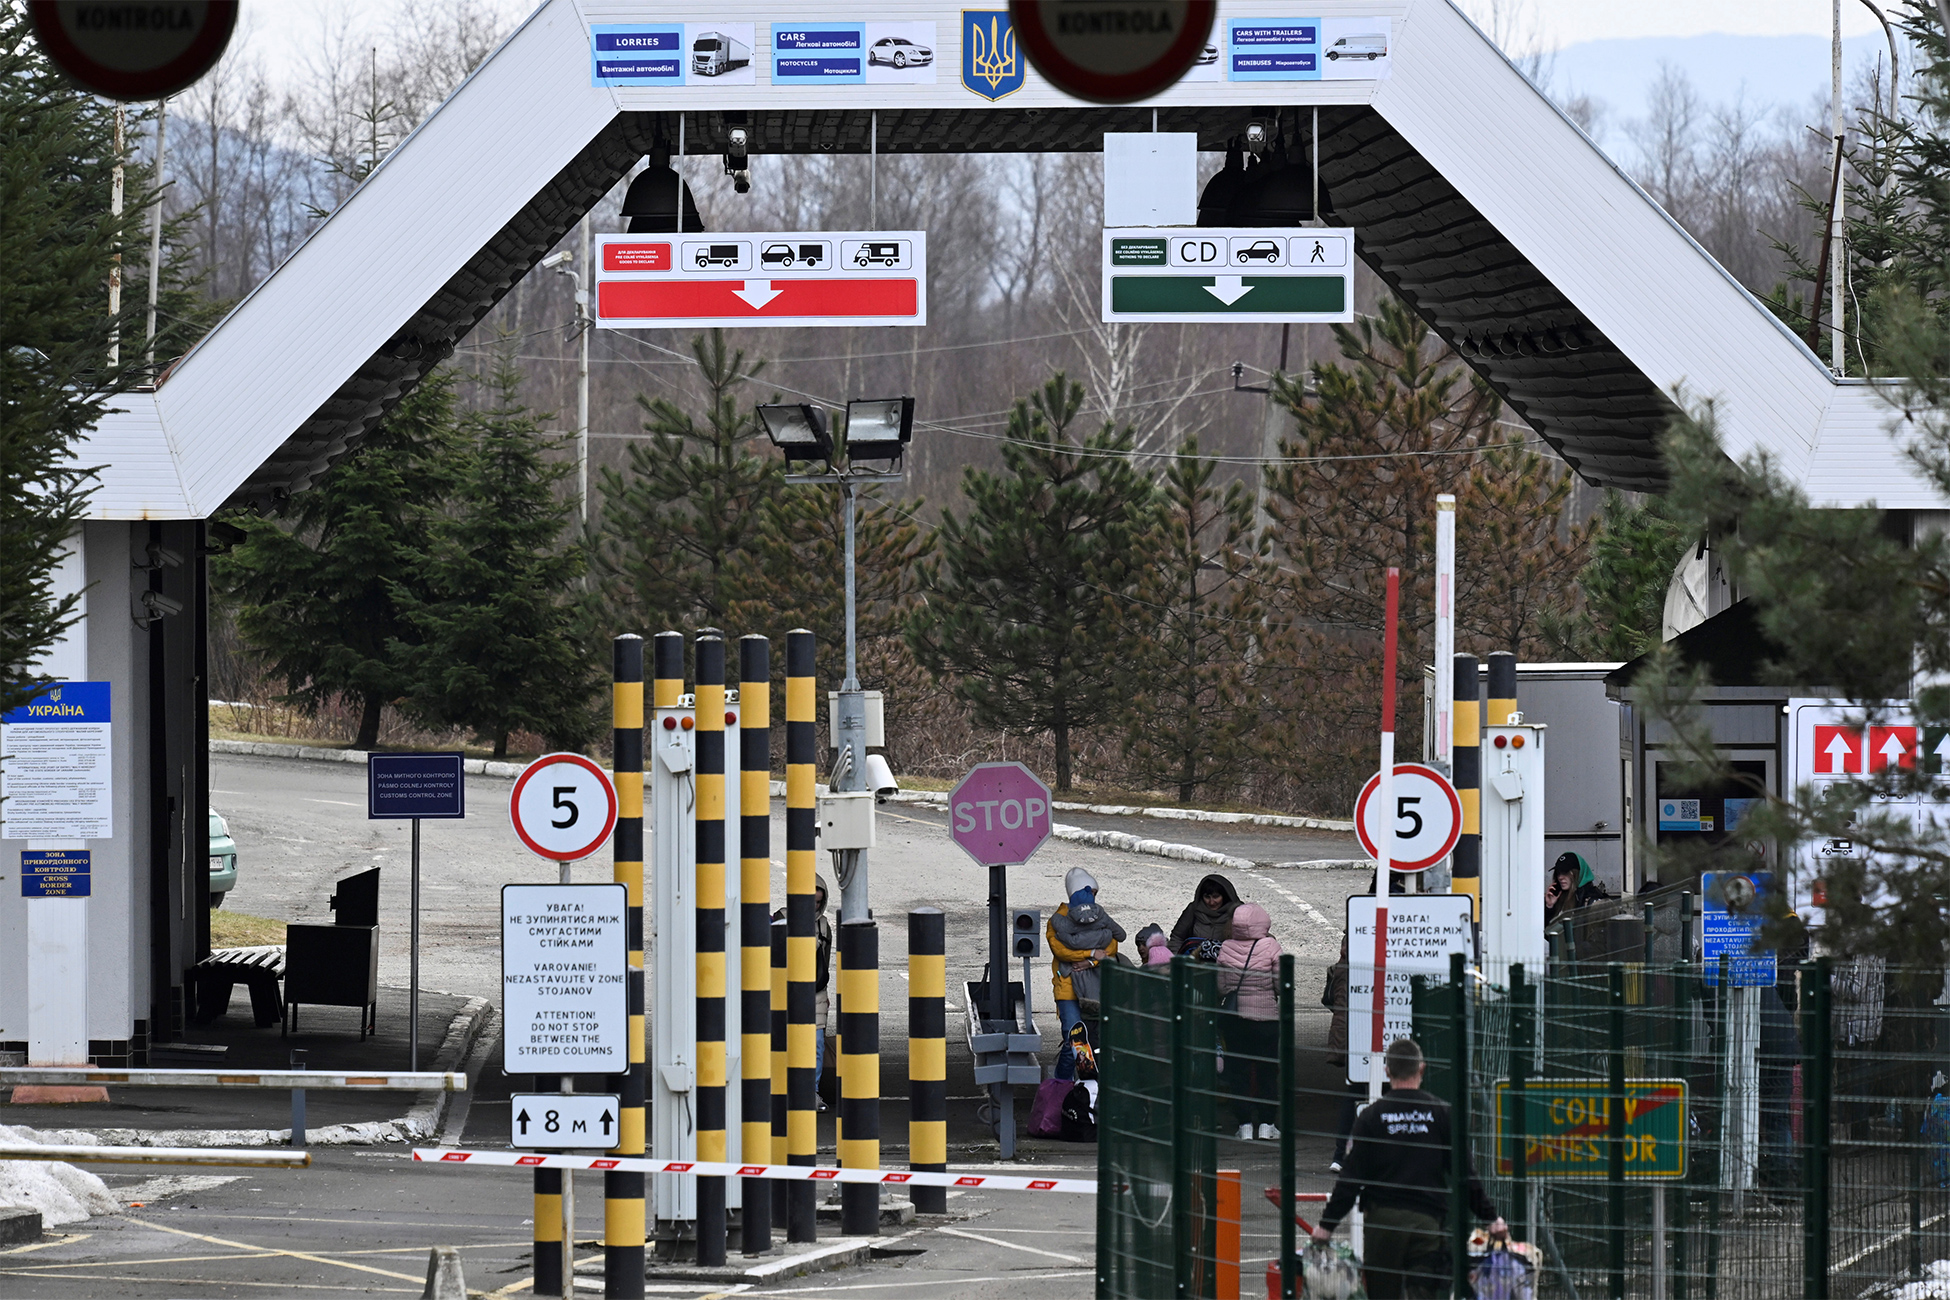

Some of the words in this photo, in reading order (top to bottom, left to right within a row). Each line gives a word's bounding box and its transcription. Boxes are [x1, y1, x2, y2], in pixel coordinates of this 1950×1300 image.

[75, 6, 194, 30] KONTROLA
[1057, 10, 1173, 34] KONTROLA
[780, 33, 806, 41] CARS
[616, 38, 659, 46] LORRIES
[601, 65, 635, 73] Вантажні
[1180, 241, 1217, 262] CD
[27, 703, 85, 717] УКРАЇНА
[550, 786, 579, 829] 5
[954, 798, 1046, 833] STOP
[1395, 797, 1422, 839] 5
[546, 904, 584, 912] УВАГА!
[510, 916, 522, 924] НЕ
[526, 916, 595, 924] ЗУПИНЯТИСЯ
[1392, 914, 1430, 923] УВАГА!
[528, 928, 602, 936] СМУГАСТИМИ
[1355, 926, 1368, 935] НЕ
[1372, 926, 1440, 934] ЗПИНЯТИСЯ
[540, 937, 594, 948] СТІЙКАМИ
[1385, 948, 1439, 958] СТІЙКАМИ
[534, 963, 597, 972] VAROVANIE!
[506, 975, 585, 984] NEZASTAVUJTE
[589, 975, 595, 983] V
[598, 975, 624, 983] ZONE
[538, 987, 593, 995] STOJANOV
[535, 1011, 596, 1019] ATTENTION!
[532, 1023, 546, 1031] DO
[548, 1023, 570, 1031] NOT
[572, 1023, 600, 1031] STOP
[530, 1035, 578, 1043] BETWEEN
[582, 1035, 600, 1043] THE
[518, 1046, 561, 1055] STRIPED
[563, 1046, 613, 1055] COLUMNS
[1550, 1090, 1638, 1125] COLÝ
[544, 1110, 560, 1133] 8
[1525, 1134, 1657, 1162] PRIESOR
